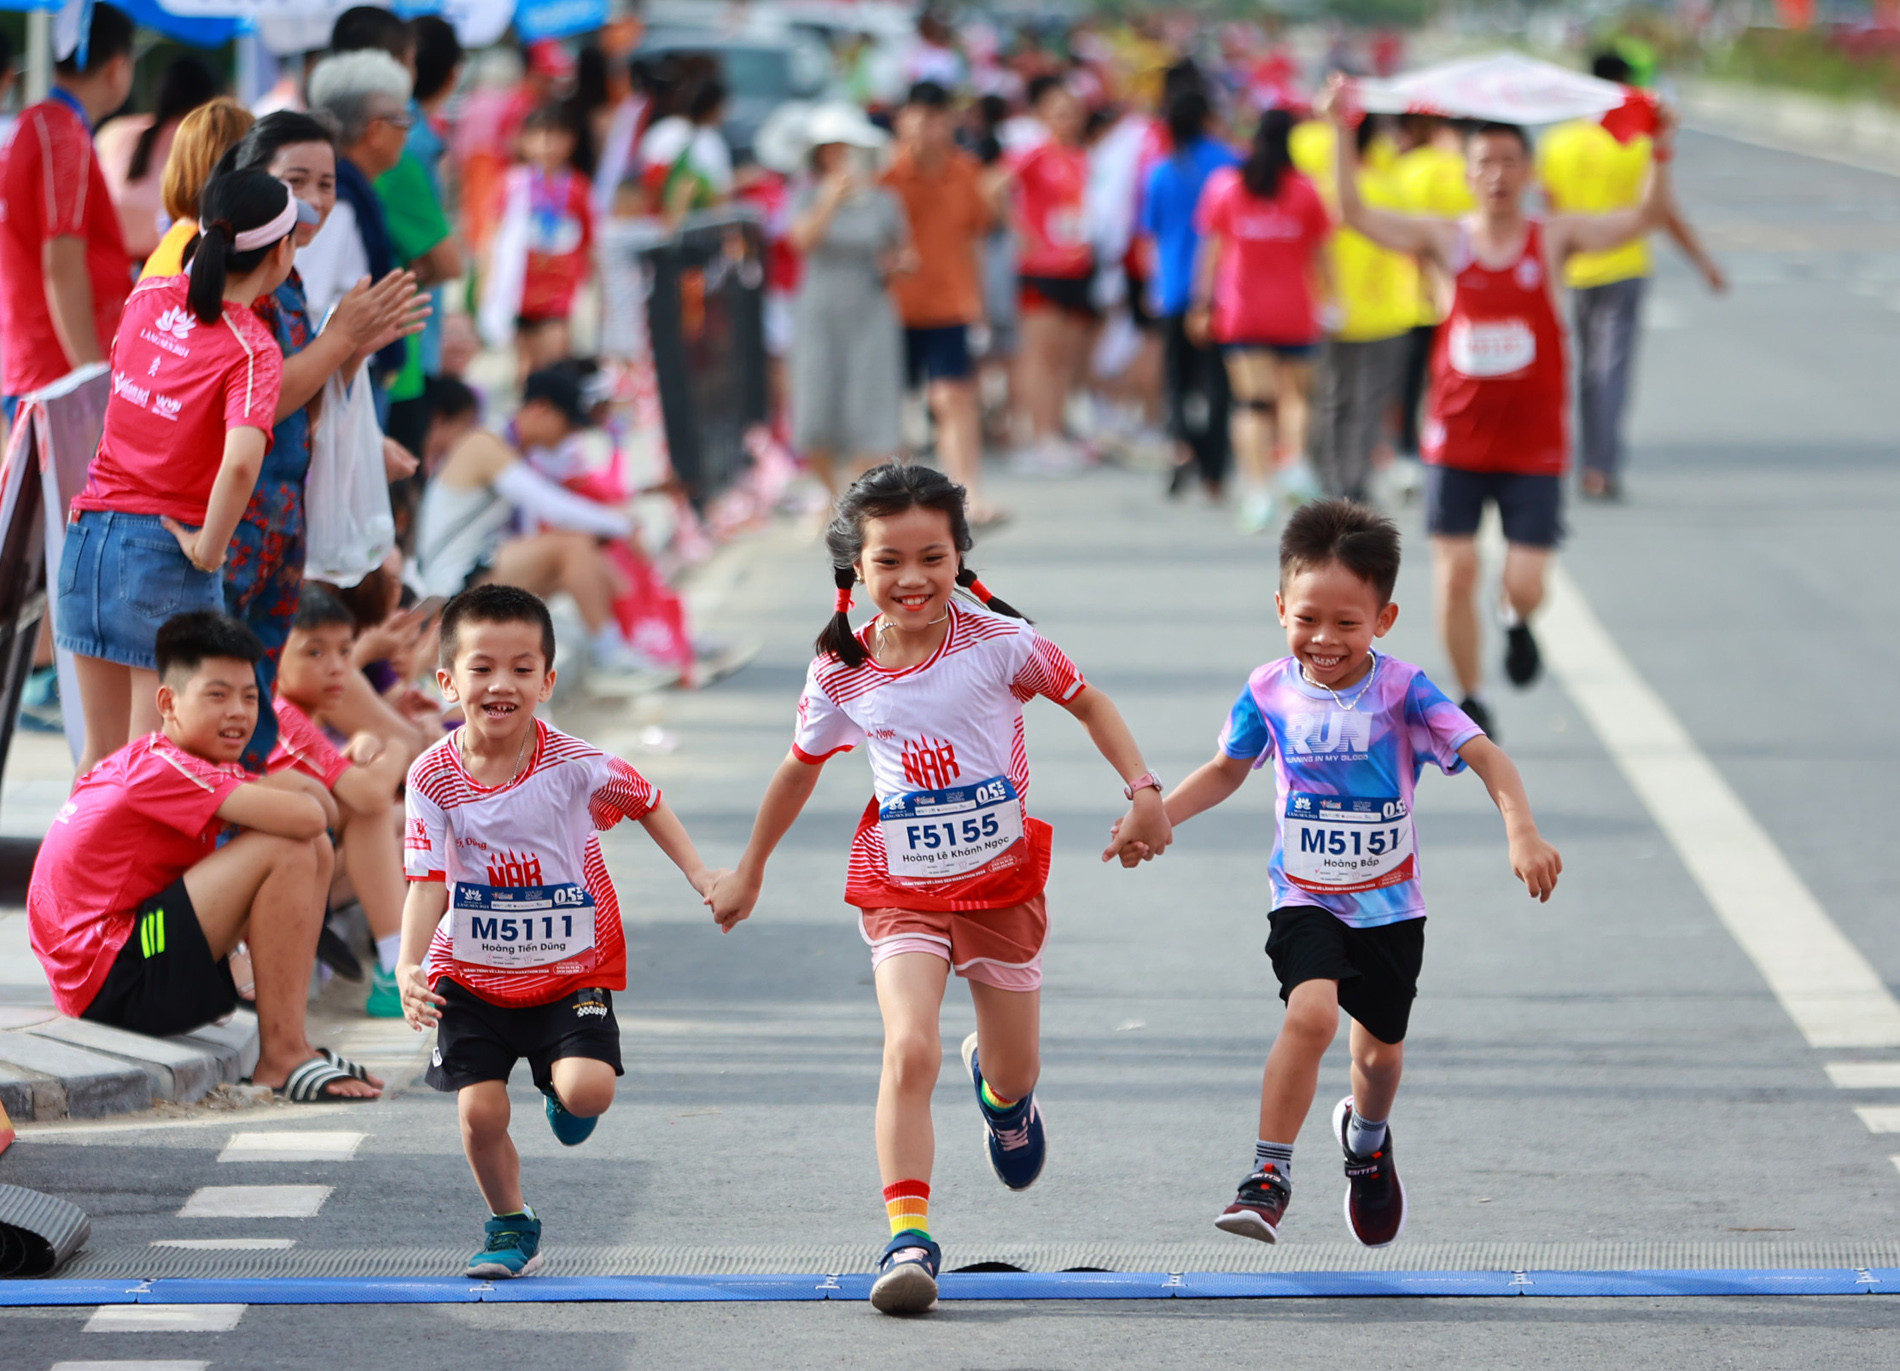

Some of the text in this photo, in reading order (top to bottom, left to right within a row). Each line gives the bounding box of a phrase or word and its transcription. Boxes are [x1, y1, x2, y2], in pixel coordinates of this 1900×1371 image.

[1286, 712, 1374, 754] RUN
[901, 743, 961, 790] NAR
[906, 812, 999, 850] F5155
[1301, 827, 1399, 856] M5151
[902, 836, 1009, 863] Hoàng Lê Khánh Ngọc
[1323, 857, 1358, 870] Hoàng
[471, 915, 572, 942] M5111
[481, 941, 566, 955] Hoàng Tiến Dũng
